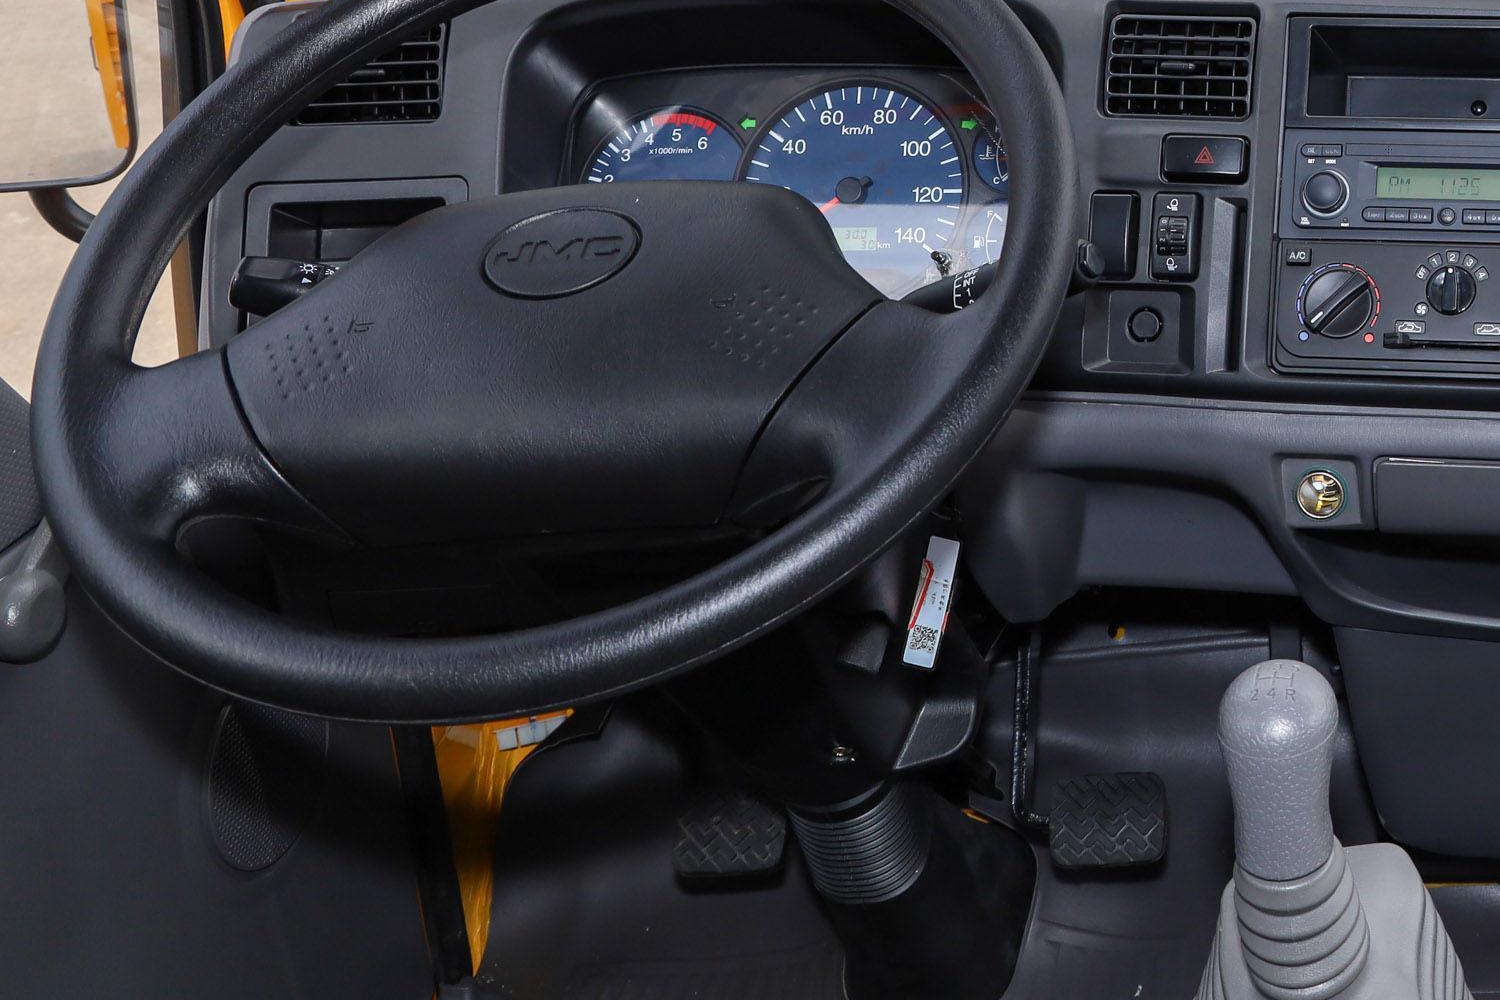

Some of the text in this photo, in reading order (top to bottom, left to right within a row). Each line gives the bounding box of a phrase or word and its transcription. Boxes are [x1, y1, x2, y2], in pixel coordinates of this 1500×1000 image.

[820, 110, 844, 126] 60
[873, 109, 897, 125] 80
[671, 128, 682, 142] 5
[841, 124, 874, 136] km/h
[644, 132, 655, 146] 4
[697, 136, 708, 150] 6
[648, 146, 693, 155] x1000r/min
[782, 139, 807, 155] 40
[900, 140, 931, 157] 100
[620, 148, 631, 162] 3
[993, 176, 1001, 185] C
[912, 186, 943, 203] 120
[986, 210, 994, 218] F
[894, 227, 926, 243] 140
[493, 236, 624, 265] JMC
[1289, 251, 1306, 260] A/C
[1431, 257, 1438, 265] 1
[1449, 253, 1456, 262] 2
[1465, 258, 1474, 267] 3
[963, 267, 979, 278] OFF
[1416, 266, 1427, 279] OFF
[1478, 271, 1487, 279] 4
[962, 275, 976, 287] INT
[966, 287, 972, 297] 1
[1250, 688, 1259, 702] 2
[1266, 687, 1276, 699] 4
[1285, 688, 1297, 702] R
